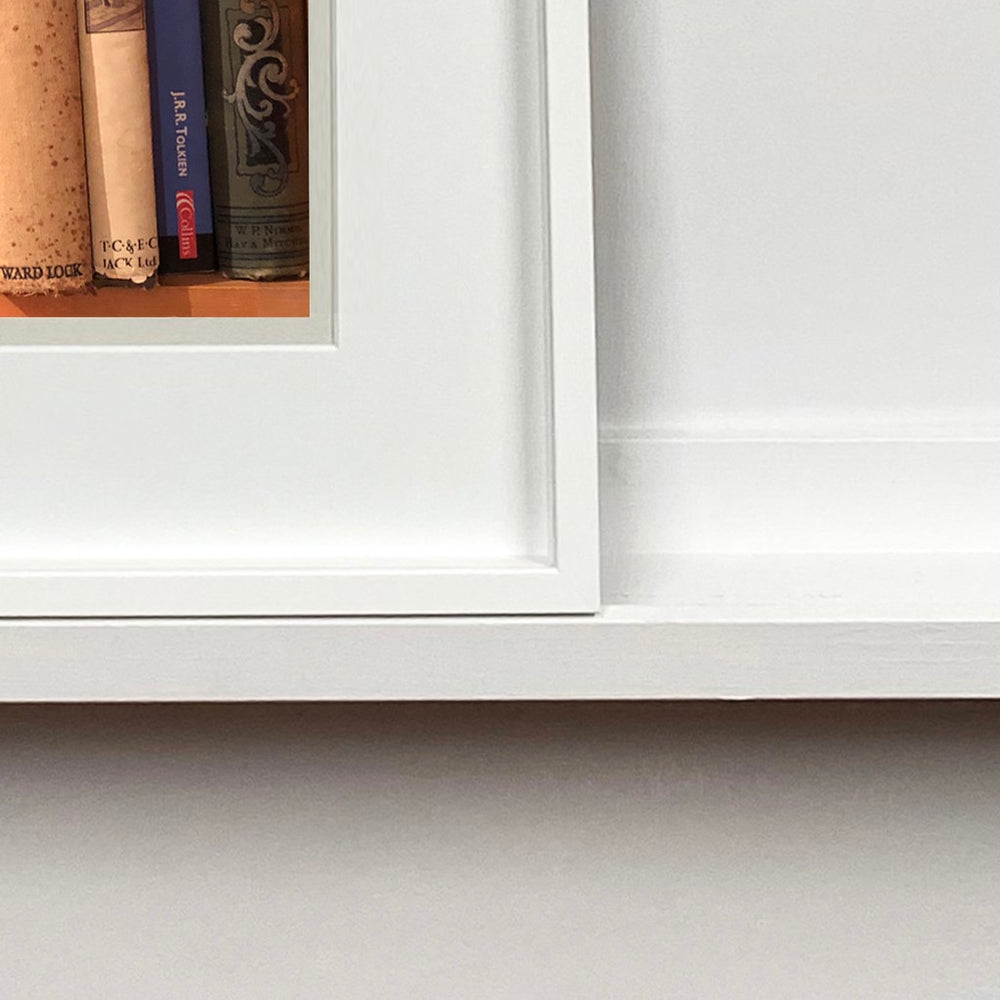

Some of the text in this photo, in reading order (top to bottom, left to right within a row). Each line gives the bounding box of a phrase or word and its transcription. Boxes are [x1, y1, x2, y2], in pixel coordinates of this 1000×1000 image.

[170, 91, 189, 177] J.R.R. TOLKIEN
[180, 206, 195, 256] Collins
[0, 262, 83, 280] WARD LOCK
